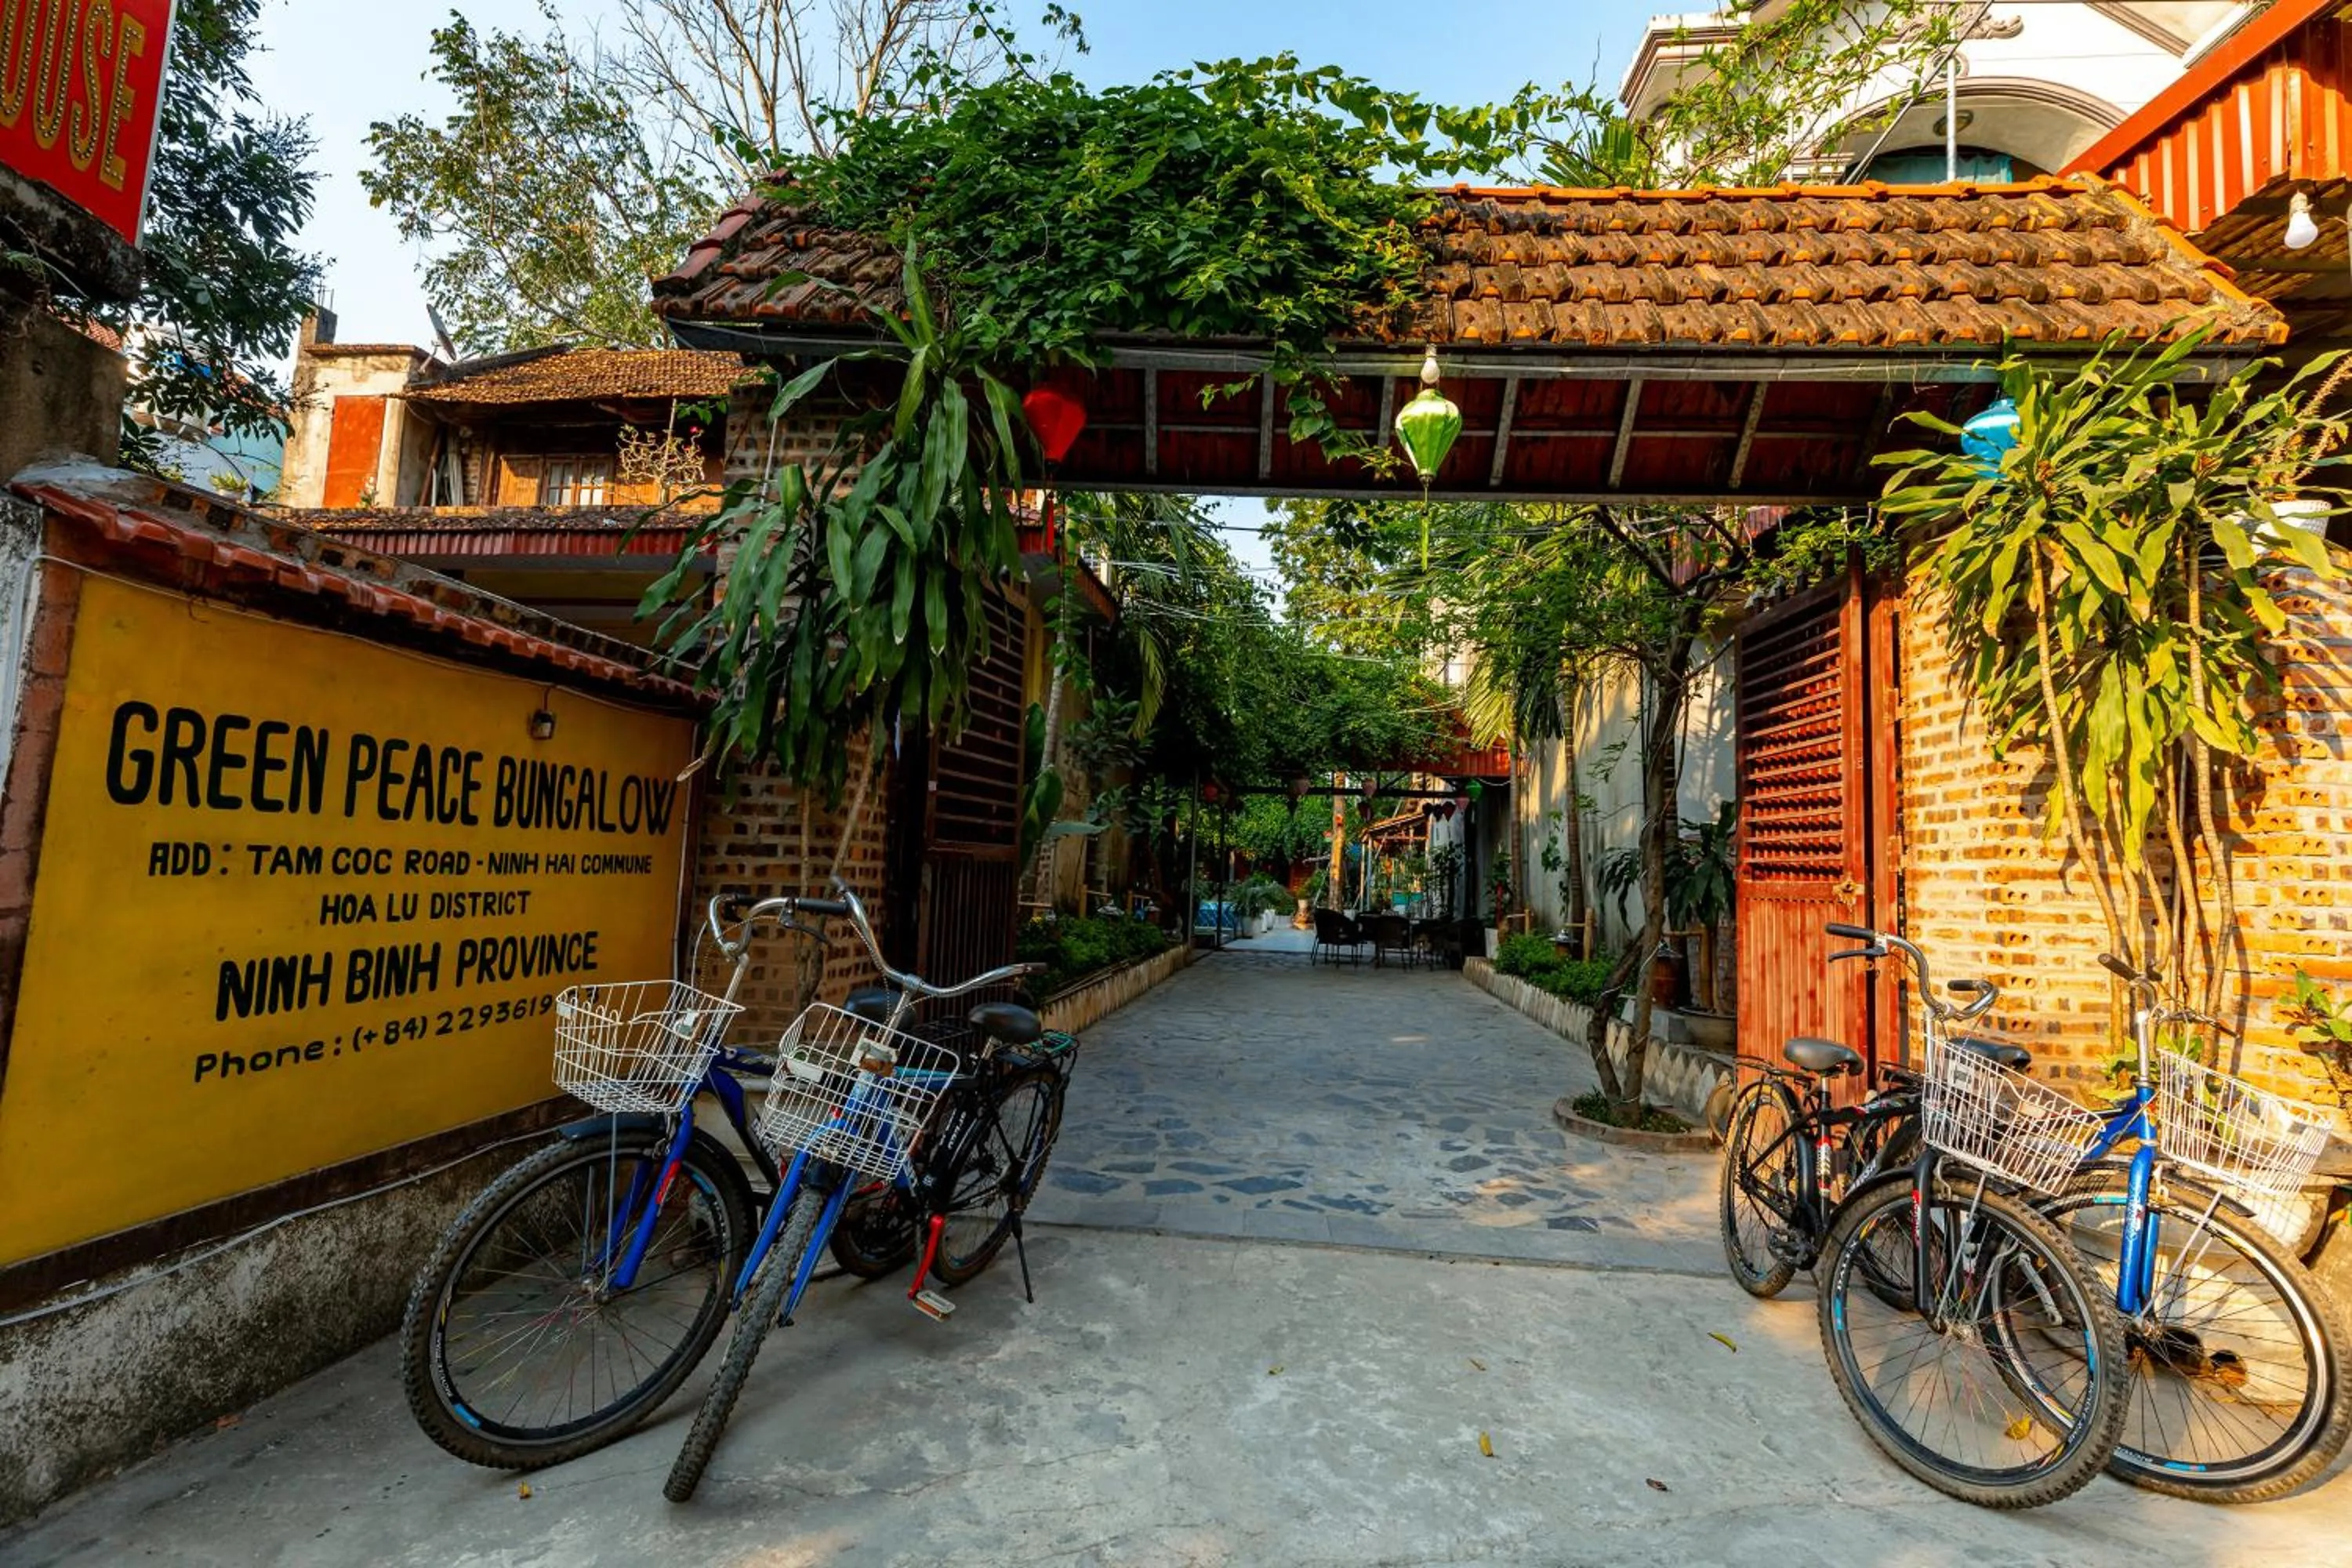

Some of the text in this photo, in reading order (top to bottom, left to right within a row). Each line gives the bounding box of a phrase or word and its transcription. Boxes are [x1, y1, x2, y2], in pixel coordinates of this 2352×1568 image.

[107, 701, 678, 837] GREEN PEACE BUNGALOW
[246, 844, 323, 875] TAM
[332, 847, 393, 876] COC
[404, 849, 470, 876] ROAD
[545, 854, 575, 874] HAI
[581, 854, 652, 875] COMMUNE
[320, 890, 532, 925] HOA LU DISTRICT
[216, 931, 598, 1022] NINH BINH PROVINCE
[353, 1015, 427, 1052] (+84)
